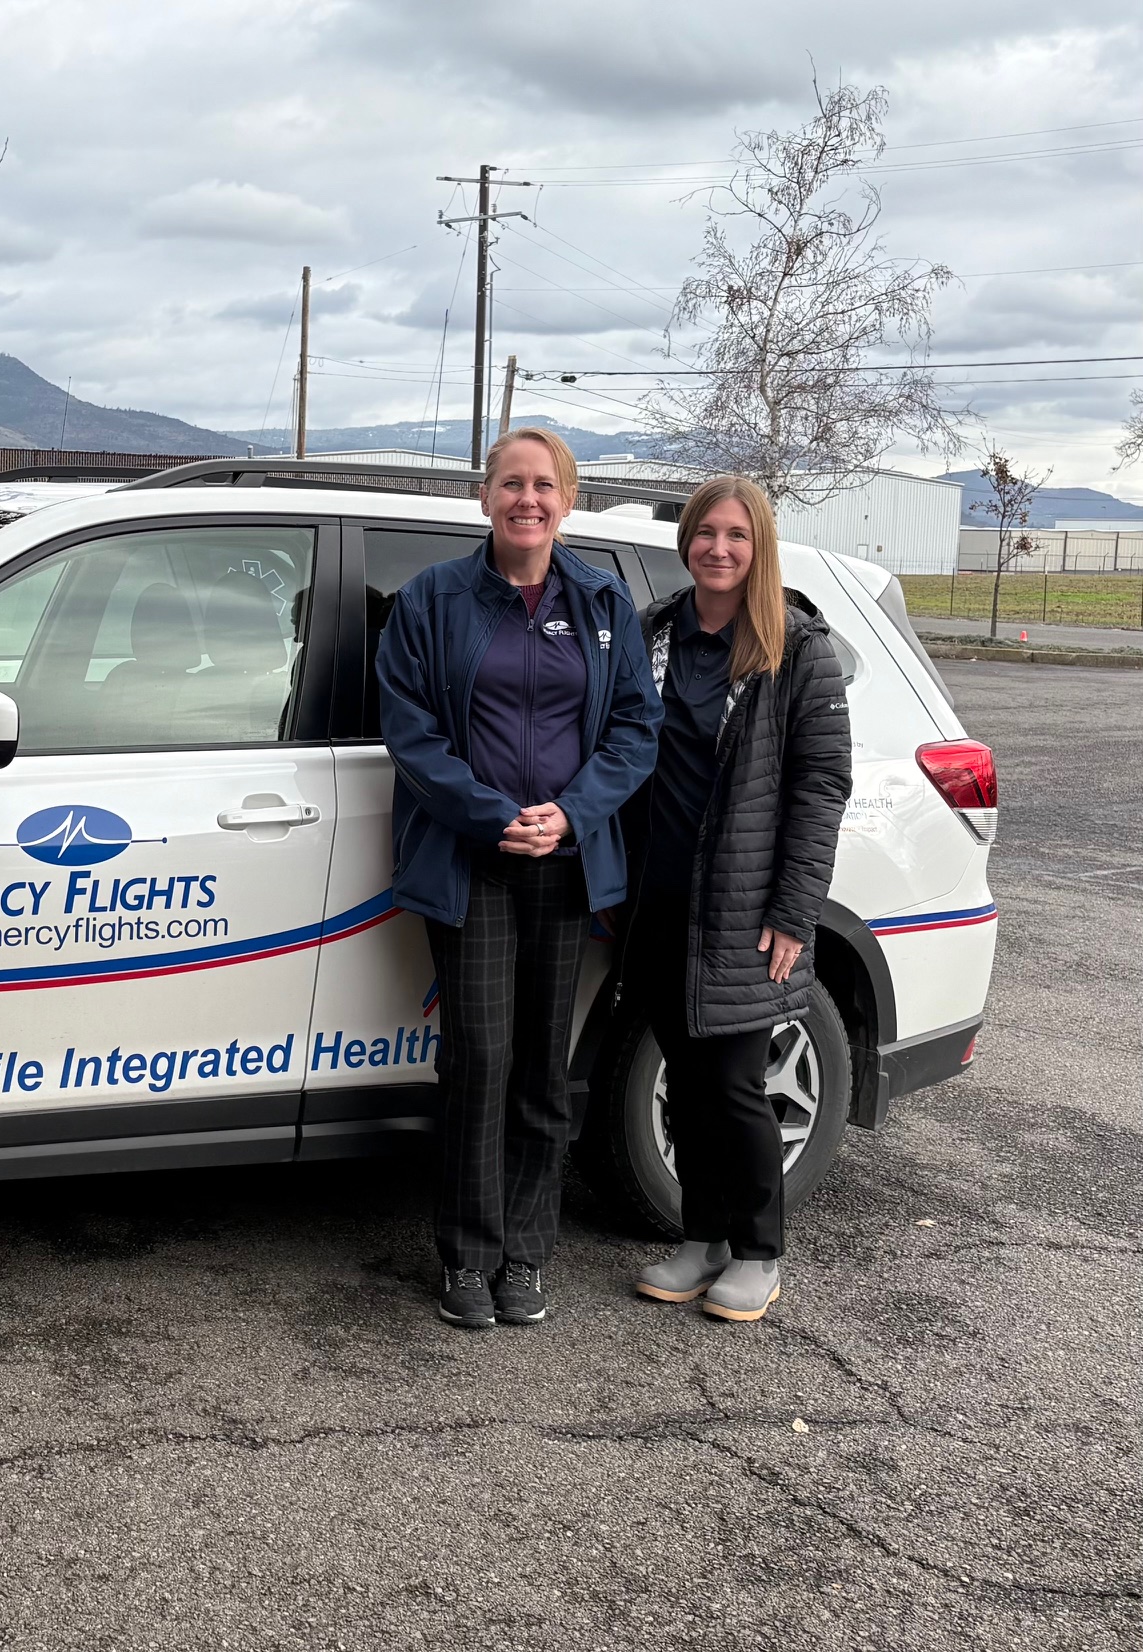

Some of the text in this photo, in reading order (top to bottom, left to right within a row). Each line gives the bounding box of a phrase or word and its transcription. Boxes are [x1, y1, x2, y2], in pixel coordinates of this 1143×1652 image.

[854, 798, 893, 809] HEALTH
[66, 869, 218, 915] FLIGHTS
[59, 1033, 294, 1091] Integrated
[310, 1024, 442, 1071] Health
